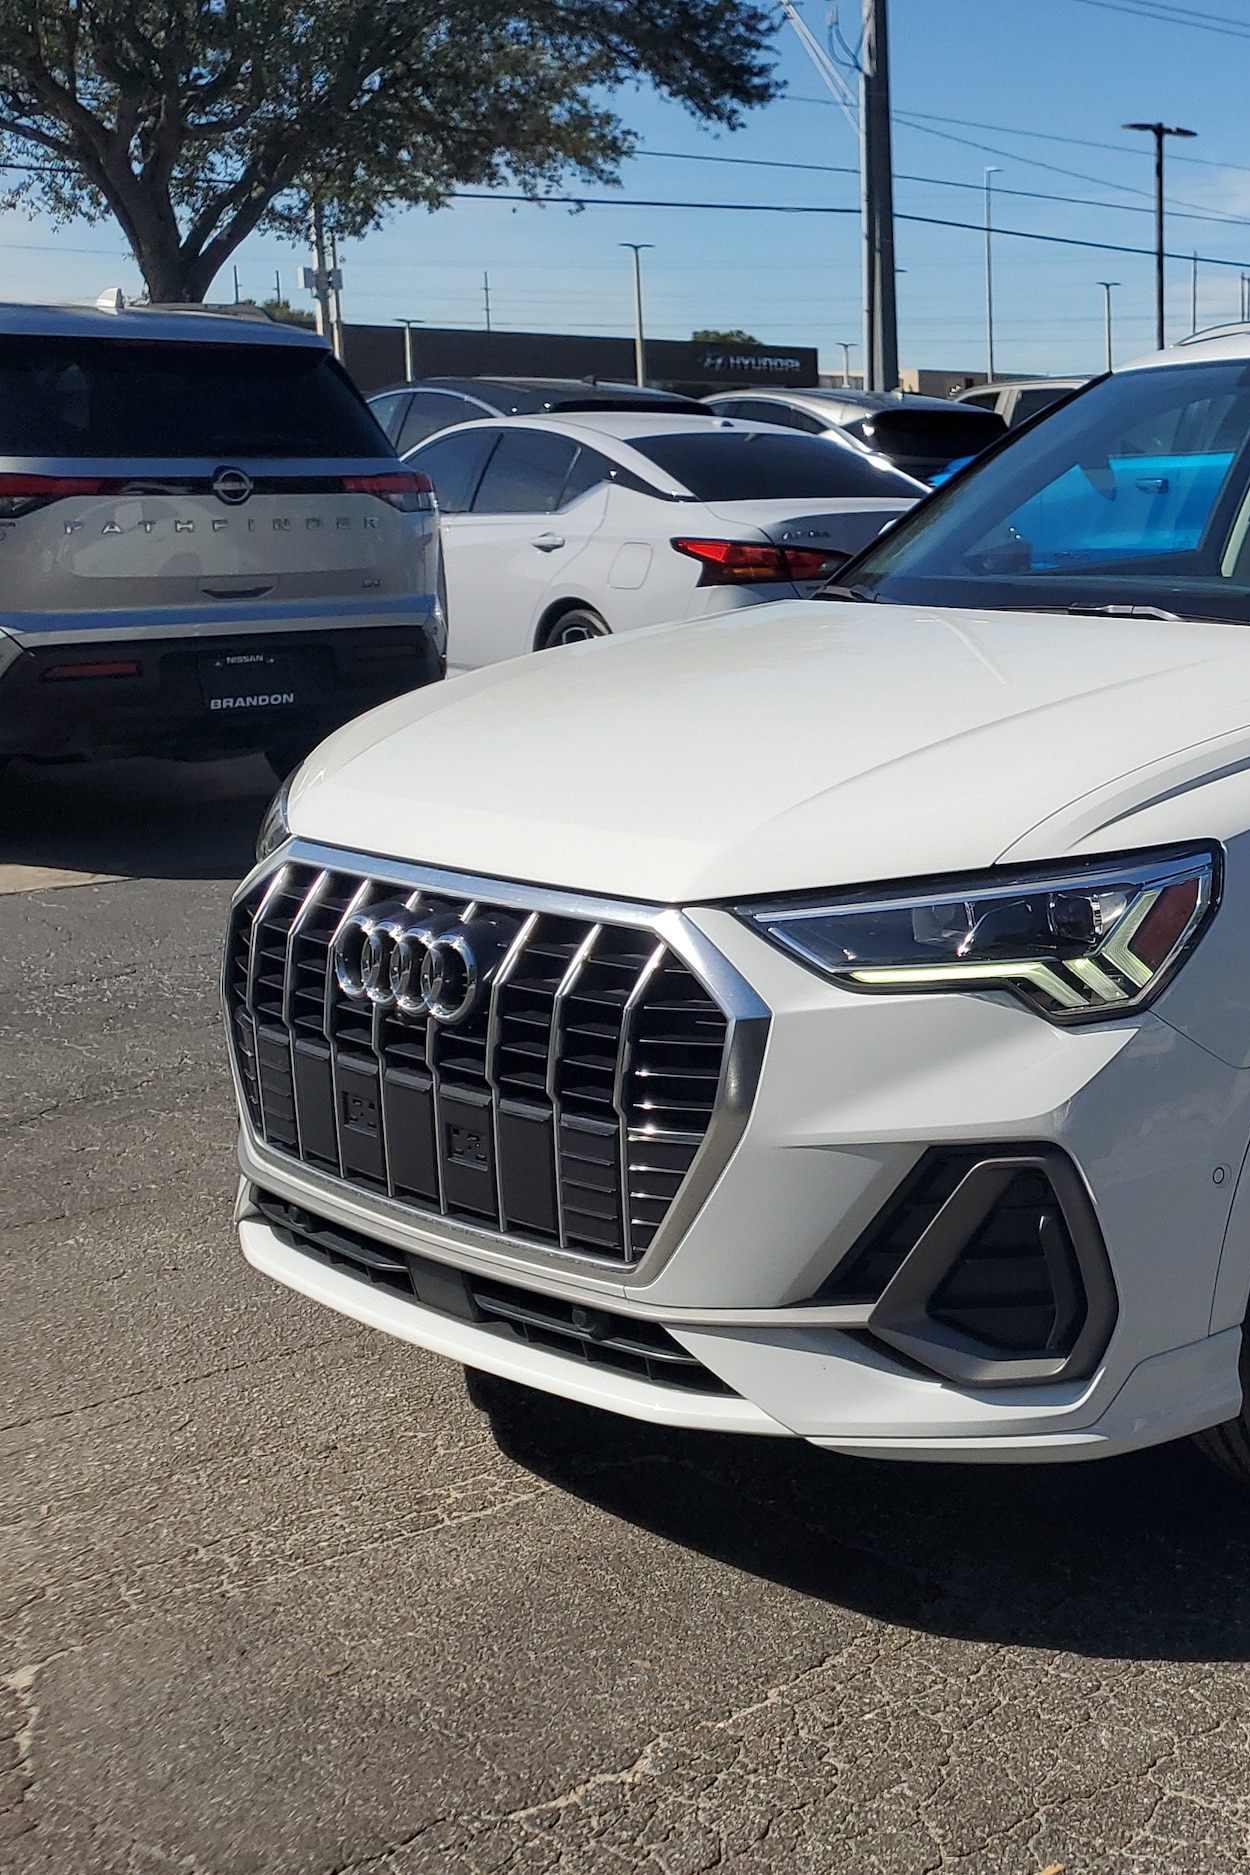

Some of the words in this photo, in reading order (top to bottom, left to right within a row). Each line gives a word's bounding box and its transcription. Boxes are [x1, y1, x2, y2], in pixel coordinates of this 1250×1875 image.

[729, 356, 800, 371] HYUNDAI
[63, 516, 380, 535] PATHFINDER
[226, 654, 264, 664] NISSAN
[209, 692, 294, 710] BRANDON
